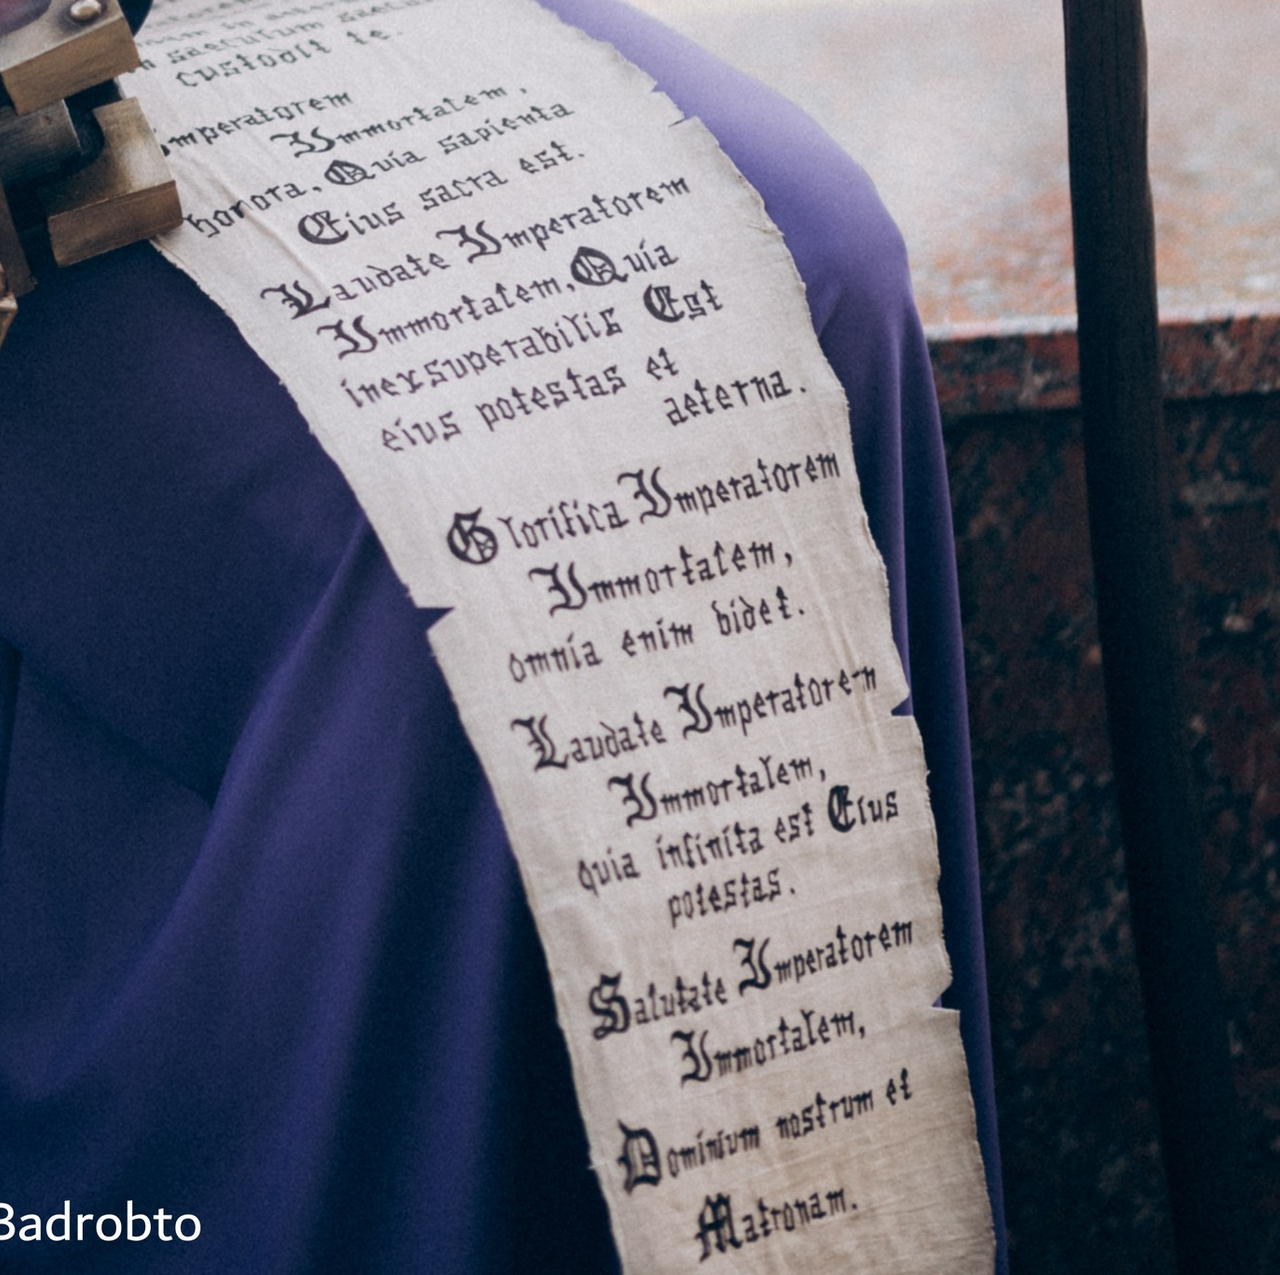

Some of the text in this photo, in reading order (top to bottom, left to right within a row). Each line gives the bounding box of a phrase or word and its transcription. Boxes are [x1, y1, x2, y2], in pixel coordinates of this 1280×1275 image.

[160, 92, 354, 157] mperatorem
[324, 150, 426, 186] Quia
[419, 168, 508, 212] sacra
[520, 140, 586, 176] est.
[261, 249, 452, 320] Laudate
[570, 238, 680, 288] Quia
[381, 347, 681, 455] eius potestas et
[664, 369, 809, 427] aeterna.
[509, 633, 603, 685] omnia
[621, 617, 695, 654] enim
[511, 710, 667, 772] Laudate
[577, 850, 641, 892] quia
[655, 822, 764, 871] infinita
[774, 803, 814, 844] est
[668, 866, 797, 927] potestas.
[588, 970, 728, 1042] Salutate
[775, 1091, 875, 1143] nostrum
[885, 1067, 913, 1107] et
[696, 1186, 859, 1264] Matronam.
